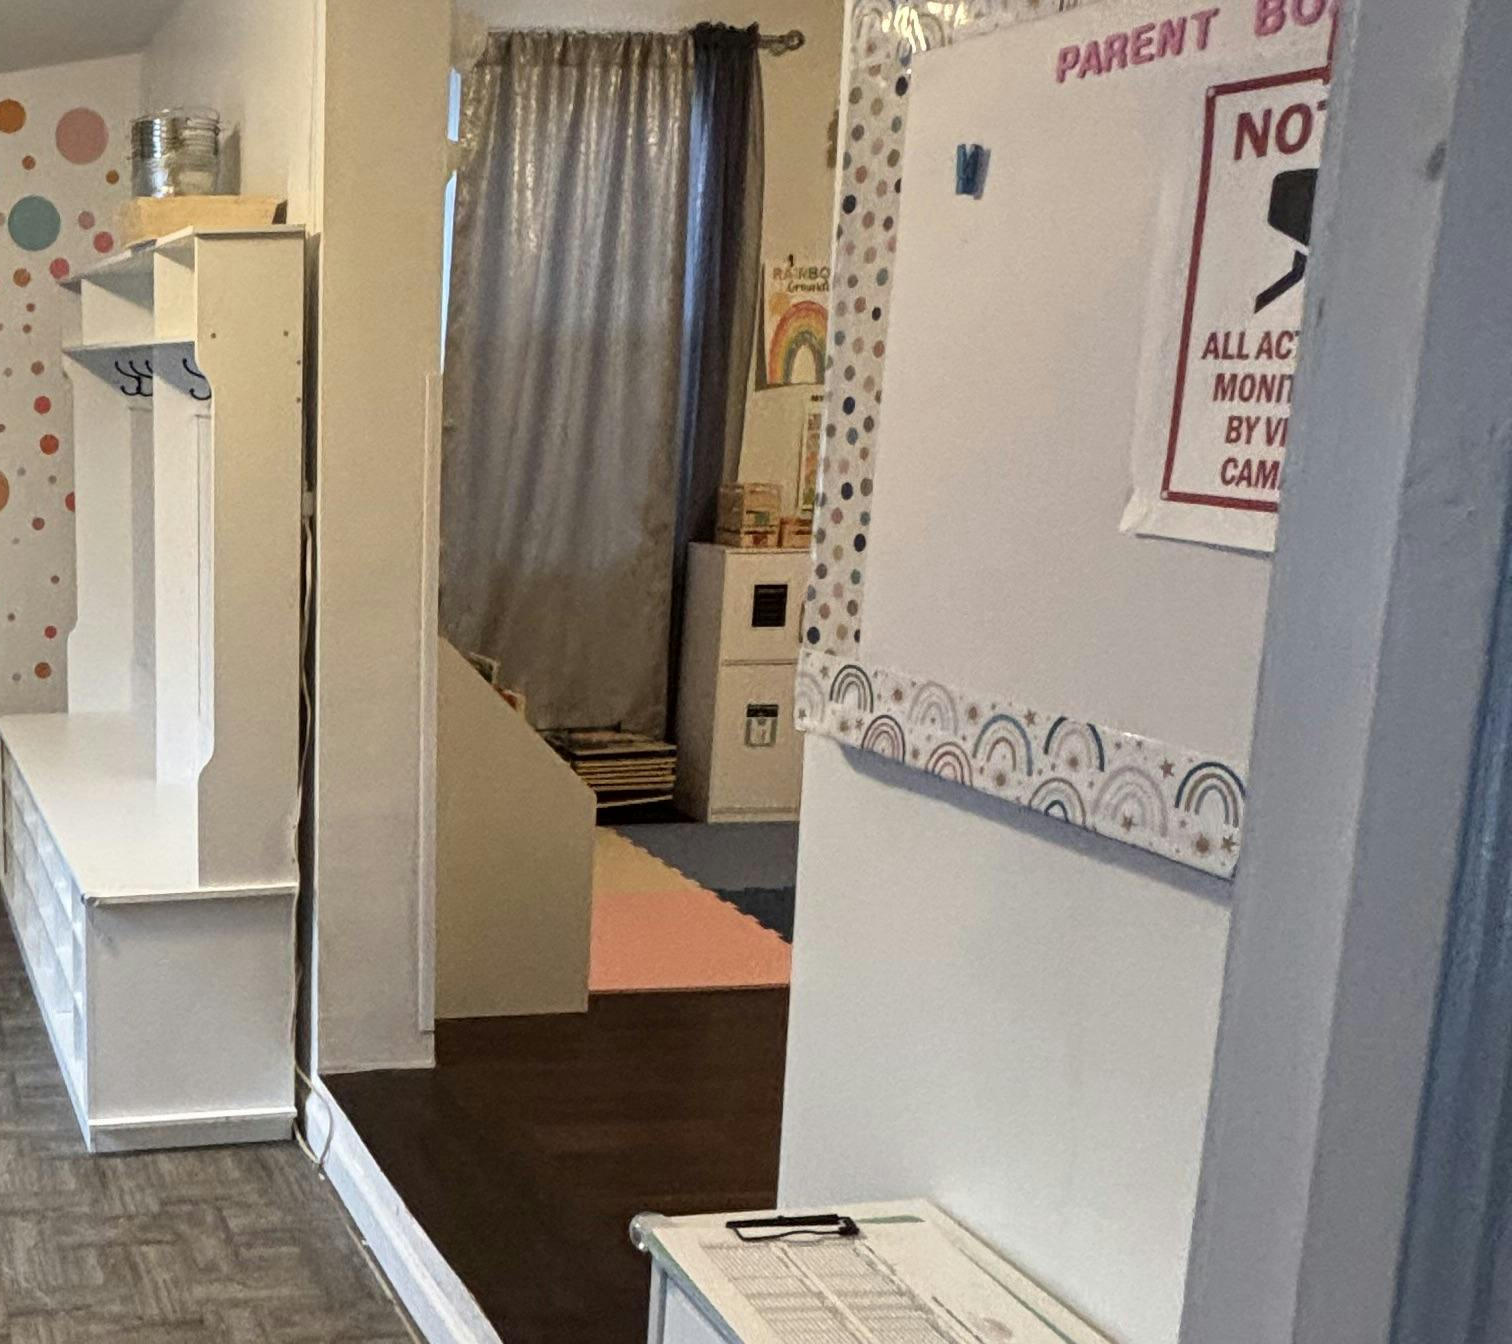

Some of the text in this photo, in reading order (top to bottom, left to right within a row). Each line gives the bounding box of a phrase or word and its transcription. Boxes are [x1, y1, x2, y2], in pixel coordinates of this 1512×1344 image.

[1054, 7, 1220, 84] PARENT
[1233, 99, 1328, 161] NO
[1201, 330, 1300, 360] ALL AC
[1225, 415, 1261, 445] BY
